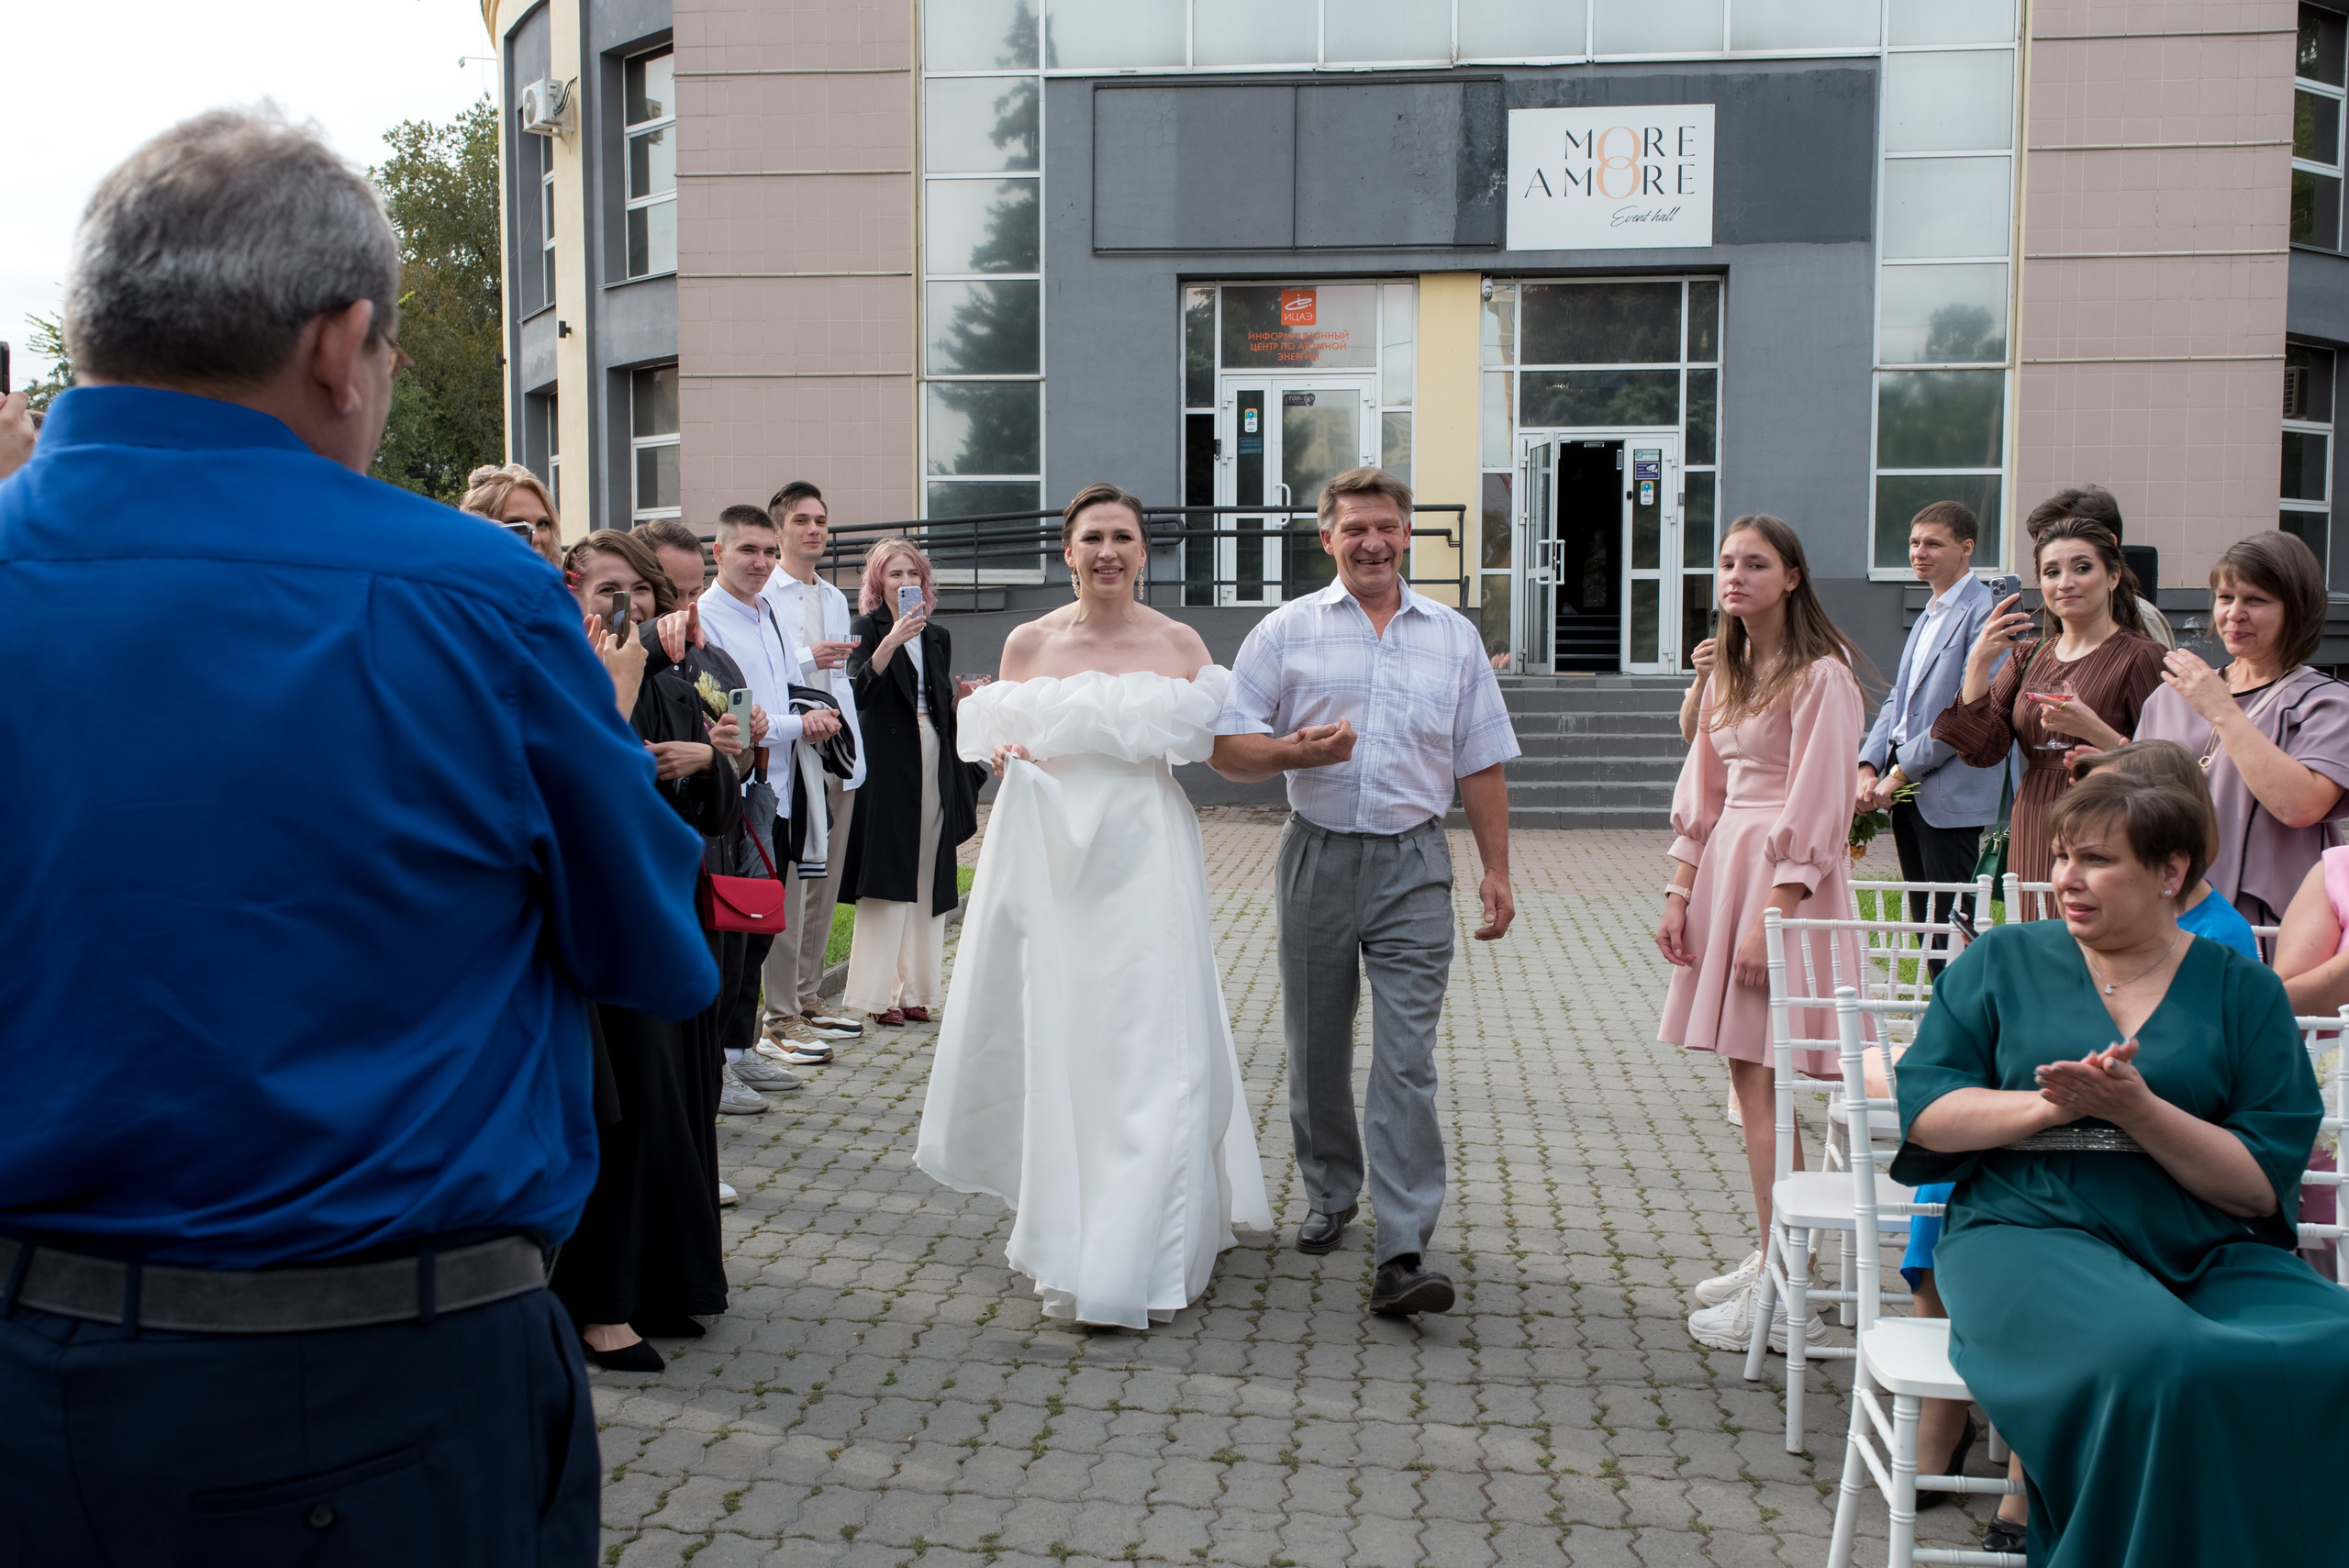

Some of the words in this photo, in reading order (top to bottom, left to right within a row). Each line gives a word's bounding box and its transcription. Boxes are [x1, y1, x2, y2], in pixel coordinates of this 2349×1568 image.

[1564, 126, 1696, 169] MORE
[1524, 157, 1695, 199] AMORE
[1610, 205, 1652, 228] Event
[1651, 206, 1681, 222] hall
[1285, 312, 1313, 322] ИЦАЭ
[1248, 330, 1350, 340] ИНФОРМАЦИОННЫЙ
[1250, 342, 1278, 352] ЦЕНТР
[1281, 342, 1296, 350] ПО
[1297, 340, 1347, 350] АТОМНОЙ
[1277, 352, 1319, 361] ЭНЕРГИИ
